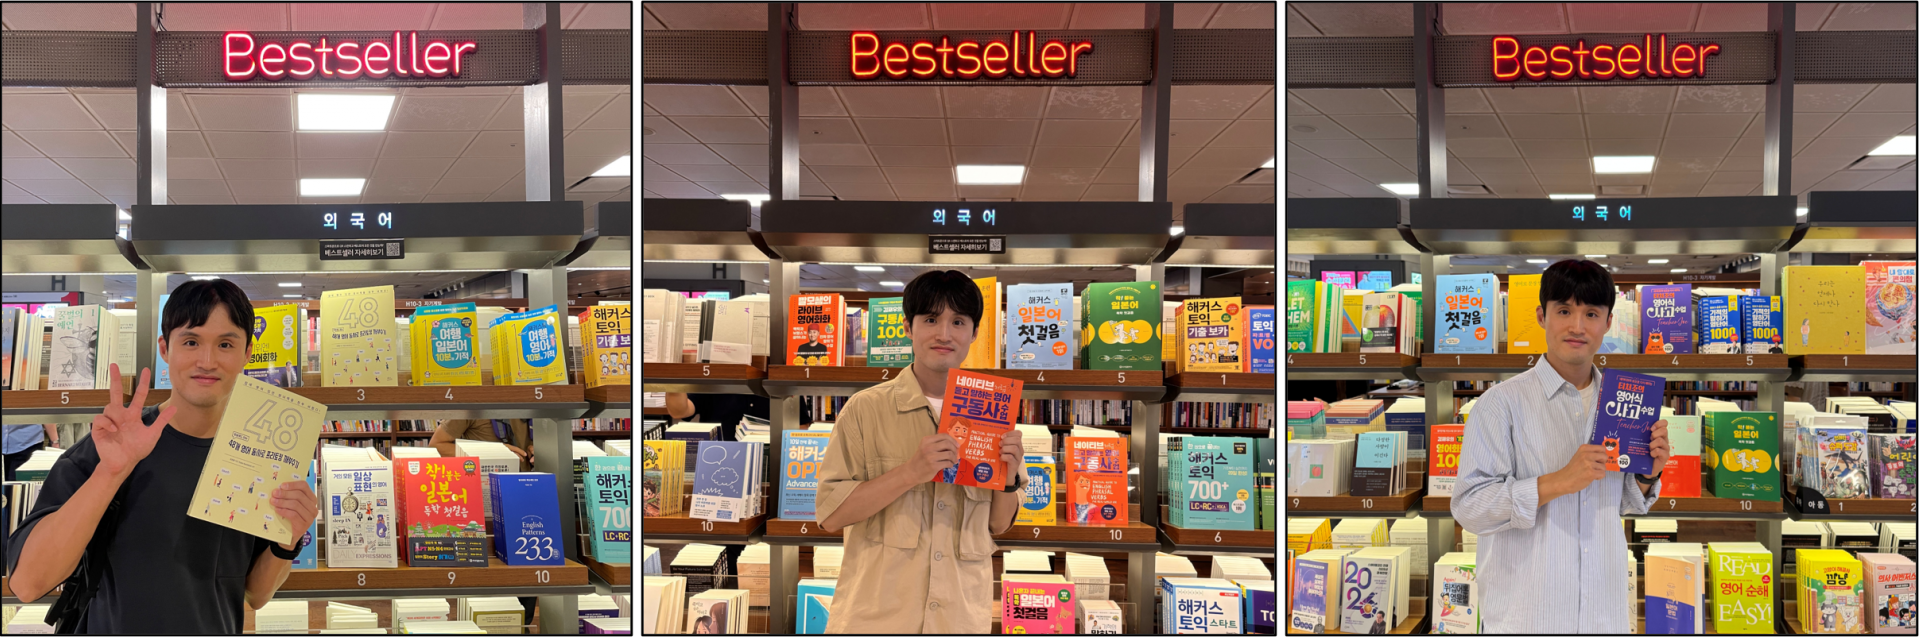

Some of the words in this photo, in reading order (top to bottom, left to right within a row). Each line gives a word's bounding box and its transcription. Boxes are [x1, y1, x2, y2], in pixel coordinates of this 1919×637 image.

[223, 31, 476, 79] Bestseller
[850, 31, 1093, 78] Bestseller
[1492, 34, 1720, 79] Bestseller
[713, 263, 727, 279] H
[51, 275, 66, 291] H
[1455, 285, 1474, 293] 해커스
[1029, 296, 1051, 304] 해커스
[1111, 301, 1139, 310] 일본어
[1445, 294, 1483, 310] 일본어
[1653, 298, 1675, 307] 영어식
[338, 297, 379, 329] 48
[798, 306, 823, 315] 라이브
[1187, 301, 1222, 313] 해커스
[593, 307, 630, 321] 해커스
[797, 314, 831, 324] 영어회화
[1018, 306, 1061, 323] 일본어
[1187, 313, 1210, 325] 토익
[1445, 310, 1481, 330] 첫걸음
[57, 320, 74, 330] 예언
[595, 321, 621, 333] 토익
[1252, 321, 1274, 332] 토익
[440, 328, 461, 340] 여행
[528, 328, 548, 341] 여행
[877, 326, 906, 338] 100
[1018, 323, 1060, 345] 첫걸음
[1188, 327, 1207, 337] 기출
[1208, 326, 1228, 336] 보카
[1710, 327, 1735, 339] 1000
[1752, 327, 1778, 339] 1000
[436, 340, 467, 352] 일본어
[530, 339, 551, 353] 영어
[454, 352, 469, 360] 기적
[543, 350, 555, 359] 기적
[1359, 354, 1366, 364] 5
[1456, 355, 1460, 365] 1
[1527, 356, 1534, 365] 2
[1671, 356, 1679, 365] 4
[1746, 355, 1753, 366] 5
[1600, 356, 1607, 366] 3
[1843, 356, 1848, 366] 1
[703, 365, 710, 376] 5
[805, 368, 809, 378] 1
[881, 369, 889, 379] 2
[1037, 371, 1045, 382] 4
[956, 375, 995, 391] 네이티브
[1118, 372, 1125, 383] 5
[1221, 374, 1226, 385] 1
[61, 392, 70, 404] 5
[357, 389, 365, 401] 3
[445, 388, 453, 400] 4
[535, 387, 543, 400] 5
[954, 386, 970, 396] 듣고
[970, 390, 992, 400] 말하는
[993, 392, 1011, 403] 영어
[1616, 391, 1643, 405] 영어식
[951, 396, 1000, 419] 구동사
[1641, 406, 1655, 416] 수업
[243, 399, 303, 451] 48
[1617, 418, 1641, 430] Teacher
[970, 435, 993, 443] ENGLISH
[1733, 430, 1759, 439] 일본어
[228, 439, 241, 451] 48개
[241, 445, 251, 454] 영어
[968, 441, 994, 450] PHRASAL
[1073, 441, 1104, 449] 네이티브
[1829, 442, 1843, 451] 슈퍼
[1843, 442, 1858, 451] 도감
[788, 445, 827, 461] 해커스
[965, 448, 985, 456] VERBS
[1188, 451, 1228, 465] 해커스
[1073, 456, 1112, 470] 구동사
[353, 472, 372, 481] 일상
[1188, 465, 1214, 479] 토익
[596, 474, 630, 488] 해커
[786, 480, 818, 488] Advance
[420, 481, 467, 504] 일본어
[1188, 480, 1229, 500] 700+
[598, 490, 628, 505] 토익
[1293, 498, 1300, 508] 9
[1361, 499, 1373, 508] 10
[1669, 499, 1676, 509] 9
[1740, 500, 1752, 510] 10
[1839, 502, 1843, 511] 1
[1911, 503, 1916, 512] 2
[424, 504, 440, 517] 독학
[443, 505, 469, 518] 첫걸음
[522, 522, 543, 530] English
[701, 521, 714, 532] 10
[800, 523, 808, 534] 6
[1033, 527, 1040, 538] 9
[1109, 529, 1122, 540] 10
[1214, 532, 1221, 543] 6
[515, 537, 553, 561] 233
[1718, 554, 1771, 576] READ
[358, 573, 366, 586] 8
[448, 572, 456, 584] 9
[535, 570, 550, 583] 10
[1826, 573, 1848, 585] 깜냥
[1878, 574, 1891, 582] 의사
[1720, 582, 1743, 595] 영어
[1745, 585, 1769, 598] 순해
[1020, 594, 1055, 608] 일본어
[1013, 607, 1048, 620] 첫걸음
[1178, 599, 1224, 616] 해커스
[1718, 599, 1771, 625] EASY!
[1178, 615, 1208, 633] 토익
[1209, 619, 1238, 629] 스타트
